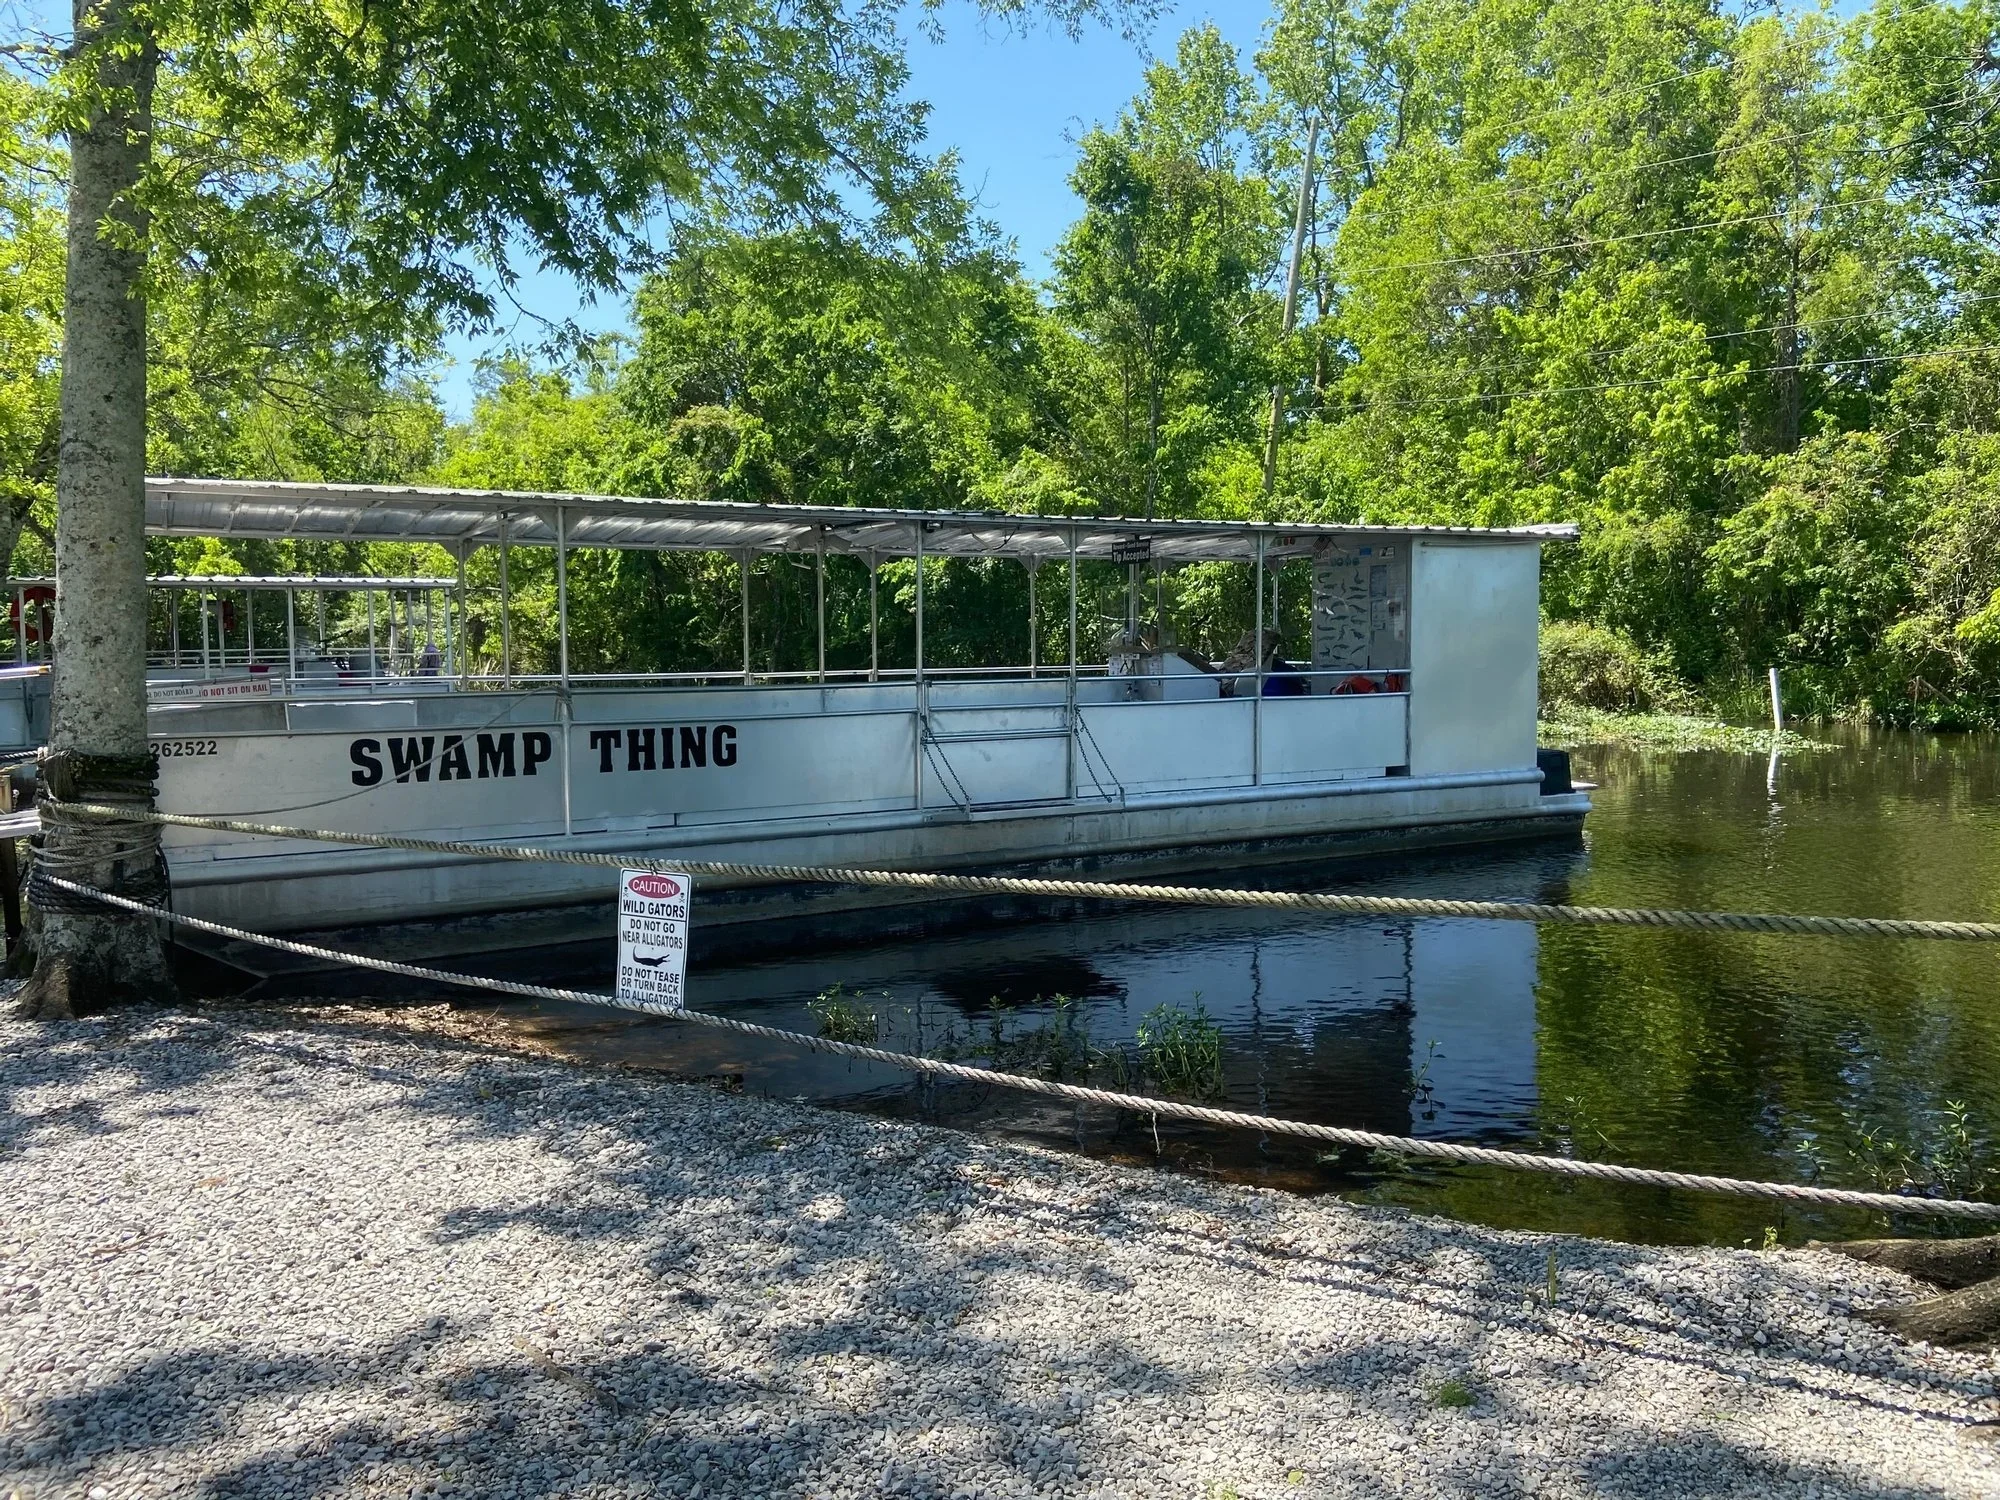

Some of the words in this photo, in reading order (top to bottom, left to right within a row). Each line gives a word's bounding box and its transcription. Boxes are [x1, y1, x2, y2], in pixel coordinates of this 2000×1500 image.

[210, 687, 225, 696] NOT
[227, 686, 239, 695] SIT
[240, 685, 251, 694] ON
[252, 683, 268, 692] RAIL
[149, 740, 218, 757] 262522
[349, 731, 552, 786] SWAMP
[590, 724, 737, 773] THING
[632, 879, 675, 895] CAUTION
[623, 900, 645, 914] WILD
[648, 902, 685, 919] GATORS
[630, 918, 642, 930] DO
[644, 920, 661, 932] NOT
[663, 922, 675, 934] GO
[622, 930, 640, 944] NEAR
[642, 933, 683, 950] ALLIGATORS
[621, 966, 633, 977] DO
[635, 967, 652, 980] NOT
[654, 970, 680, 984] TEASE
[621, 977, 632, 988] OR
[634, 978, 655, 991] TURN
[657, 982, 679, 996] BACK
[620, 988, 631, 999] TO
[632, 990, 679, 1007] ALLIGATORS
